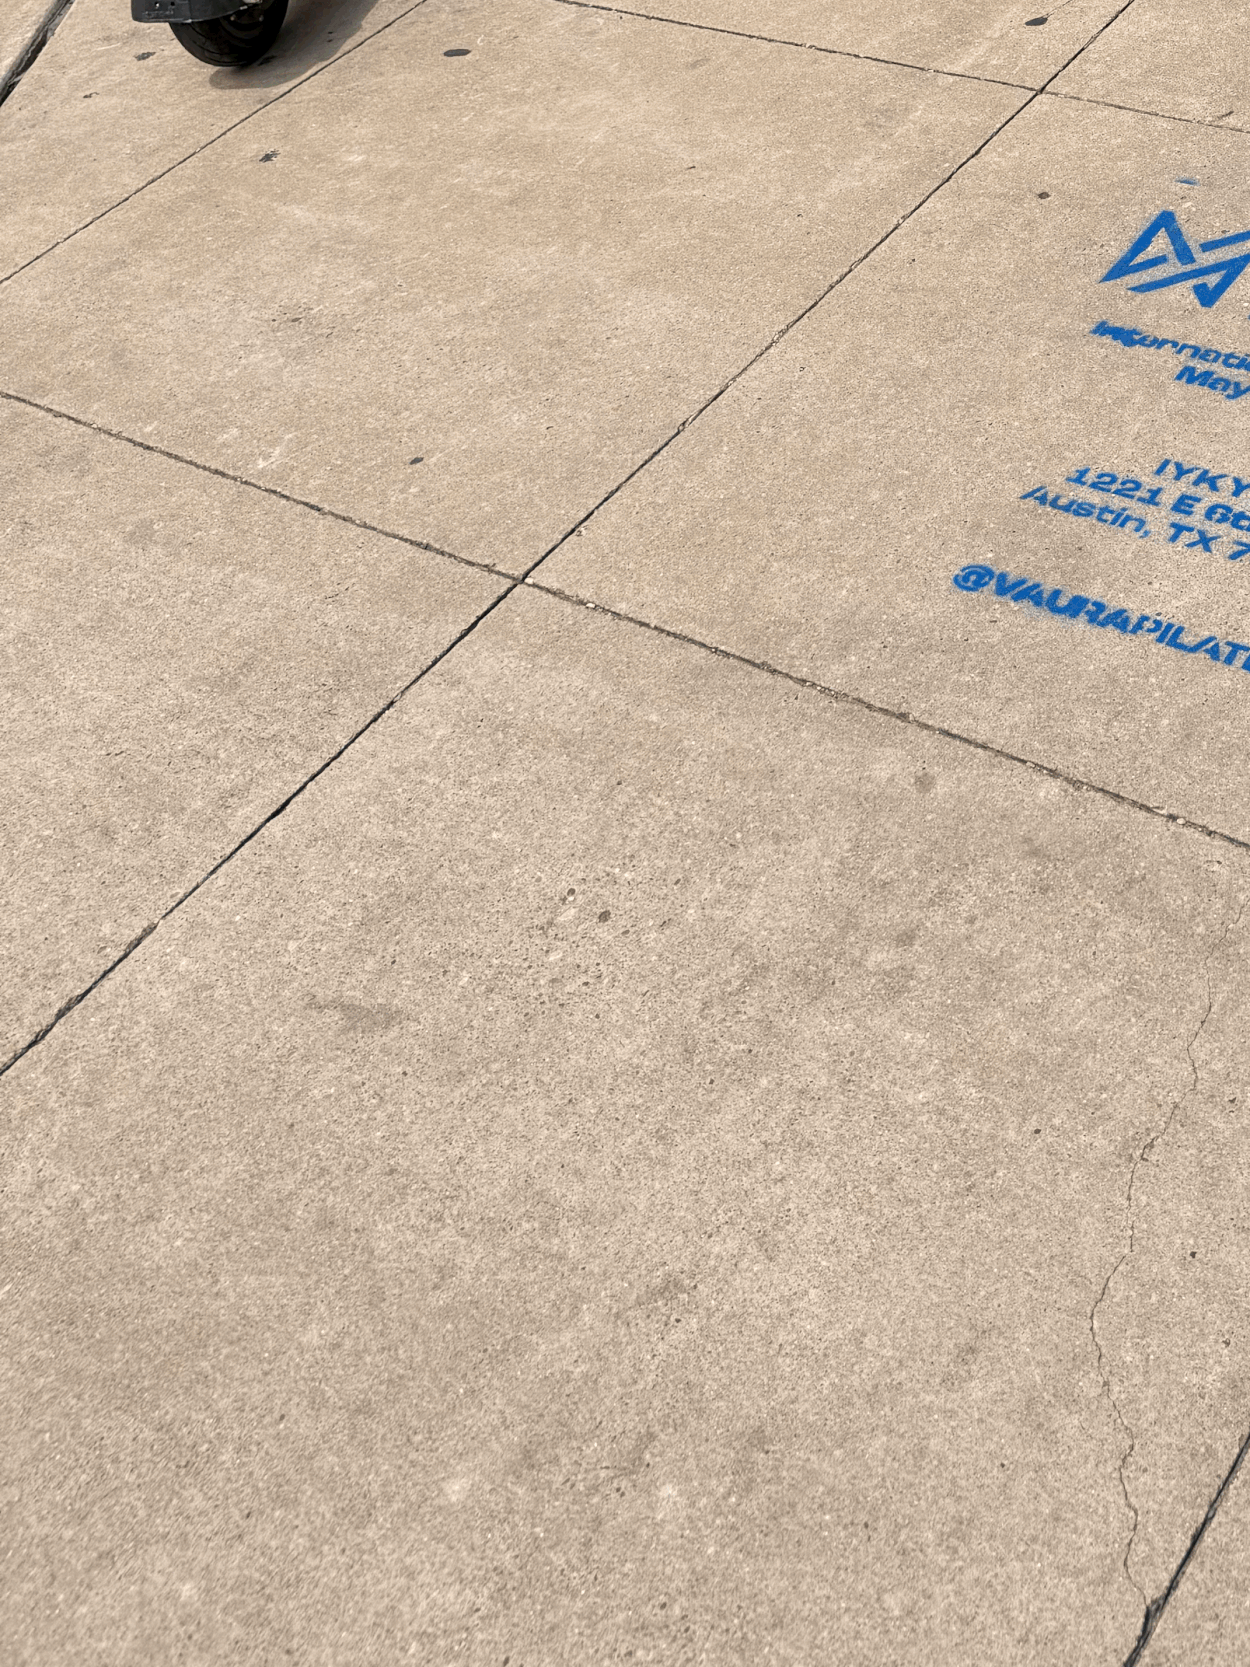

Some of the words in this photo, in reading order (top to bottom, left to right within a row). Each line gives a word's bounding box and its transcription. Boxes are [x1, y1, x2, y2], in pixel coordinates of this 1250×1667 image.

[1018, 485, 1151, 539] Austin,
[1165, 521, 1222, 553] TX
[1065, 466, 1165, 508] 1221
[1170, 489, 1203, 516] E
